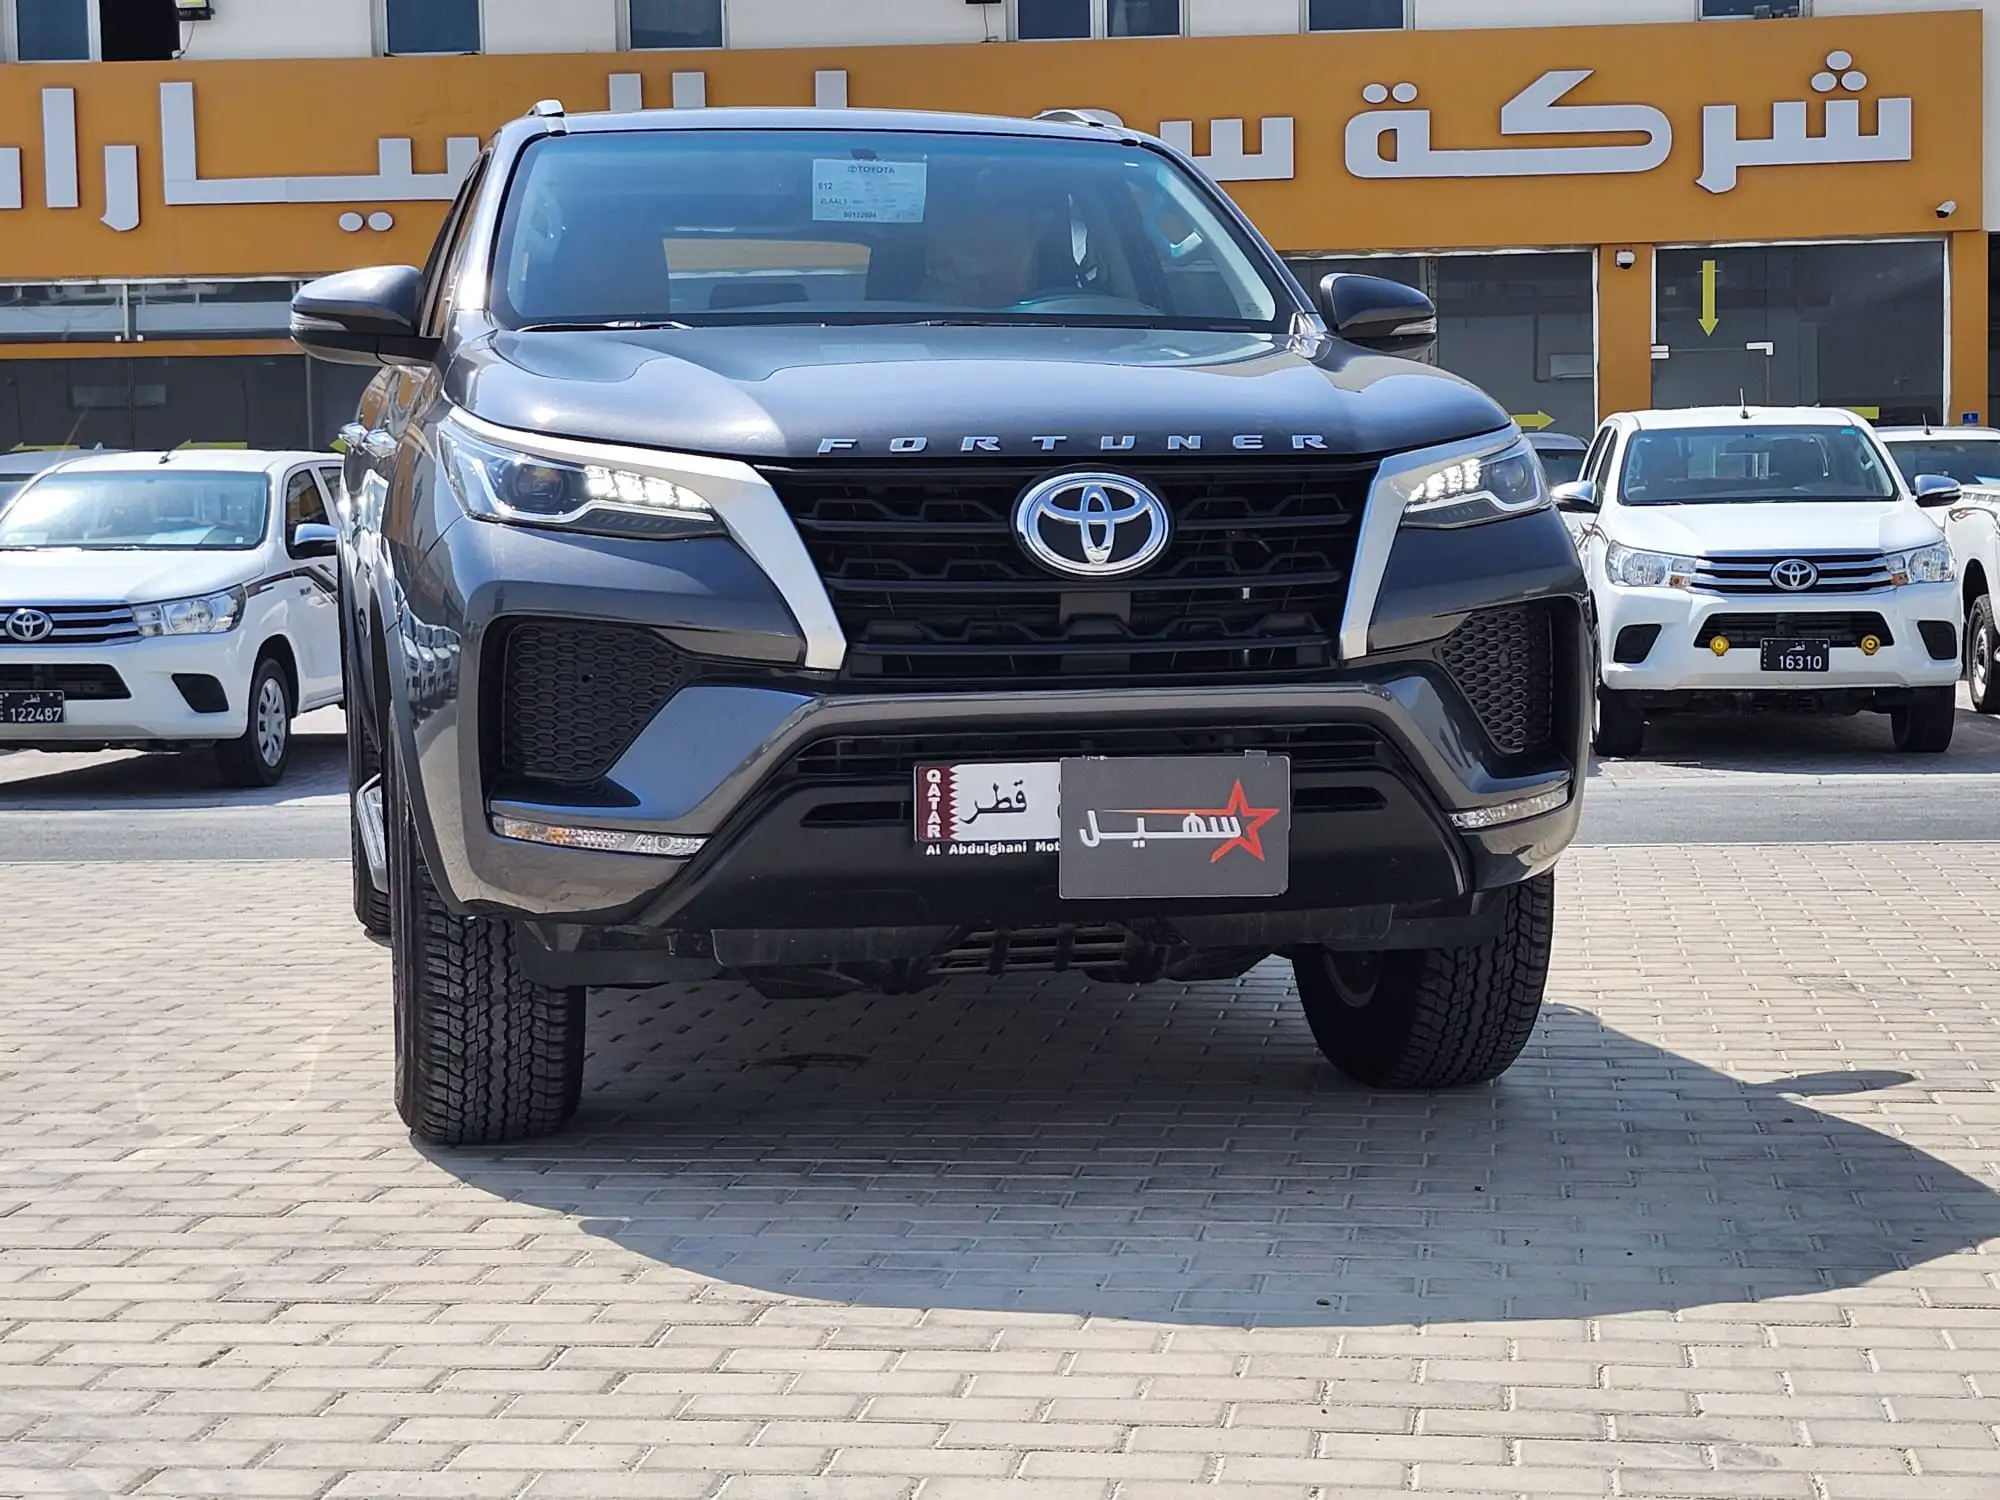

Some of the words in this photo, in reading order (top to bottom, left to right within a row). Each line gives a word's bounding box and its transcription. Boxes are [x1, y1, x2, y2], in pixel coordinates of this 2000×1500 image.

[1344, 49, 1912, 194] شركة
[858, 165, 896, 175] TOYOTA
[816, 434, 1329, 455] FORTUNER
[1779, 655, 1822, 670] 16310
[10, 707, 62, 722] 122487
[926, 769, 942, 838] QATAR
[959, 779, 1028, 824] قطر
[1079, 810, 1242, 848] سهيل
[926, 844, 941, 855] Al
[949, 841, 1027, 856] Abdulghani
[1035, 841, 1061, 852] Mot
